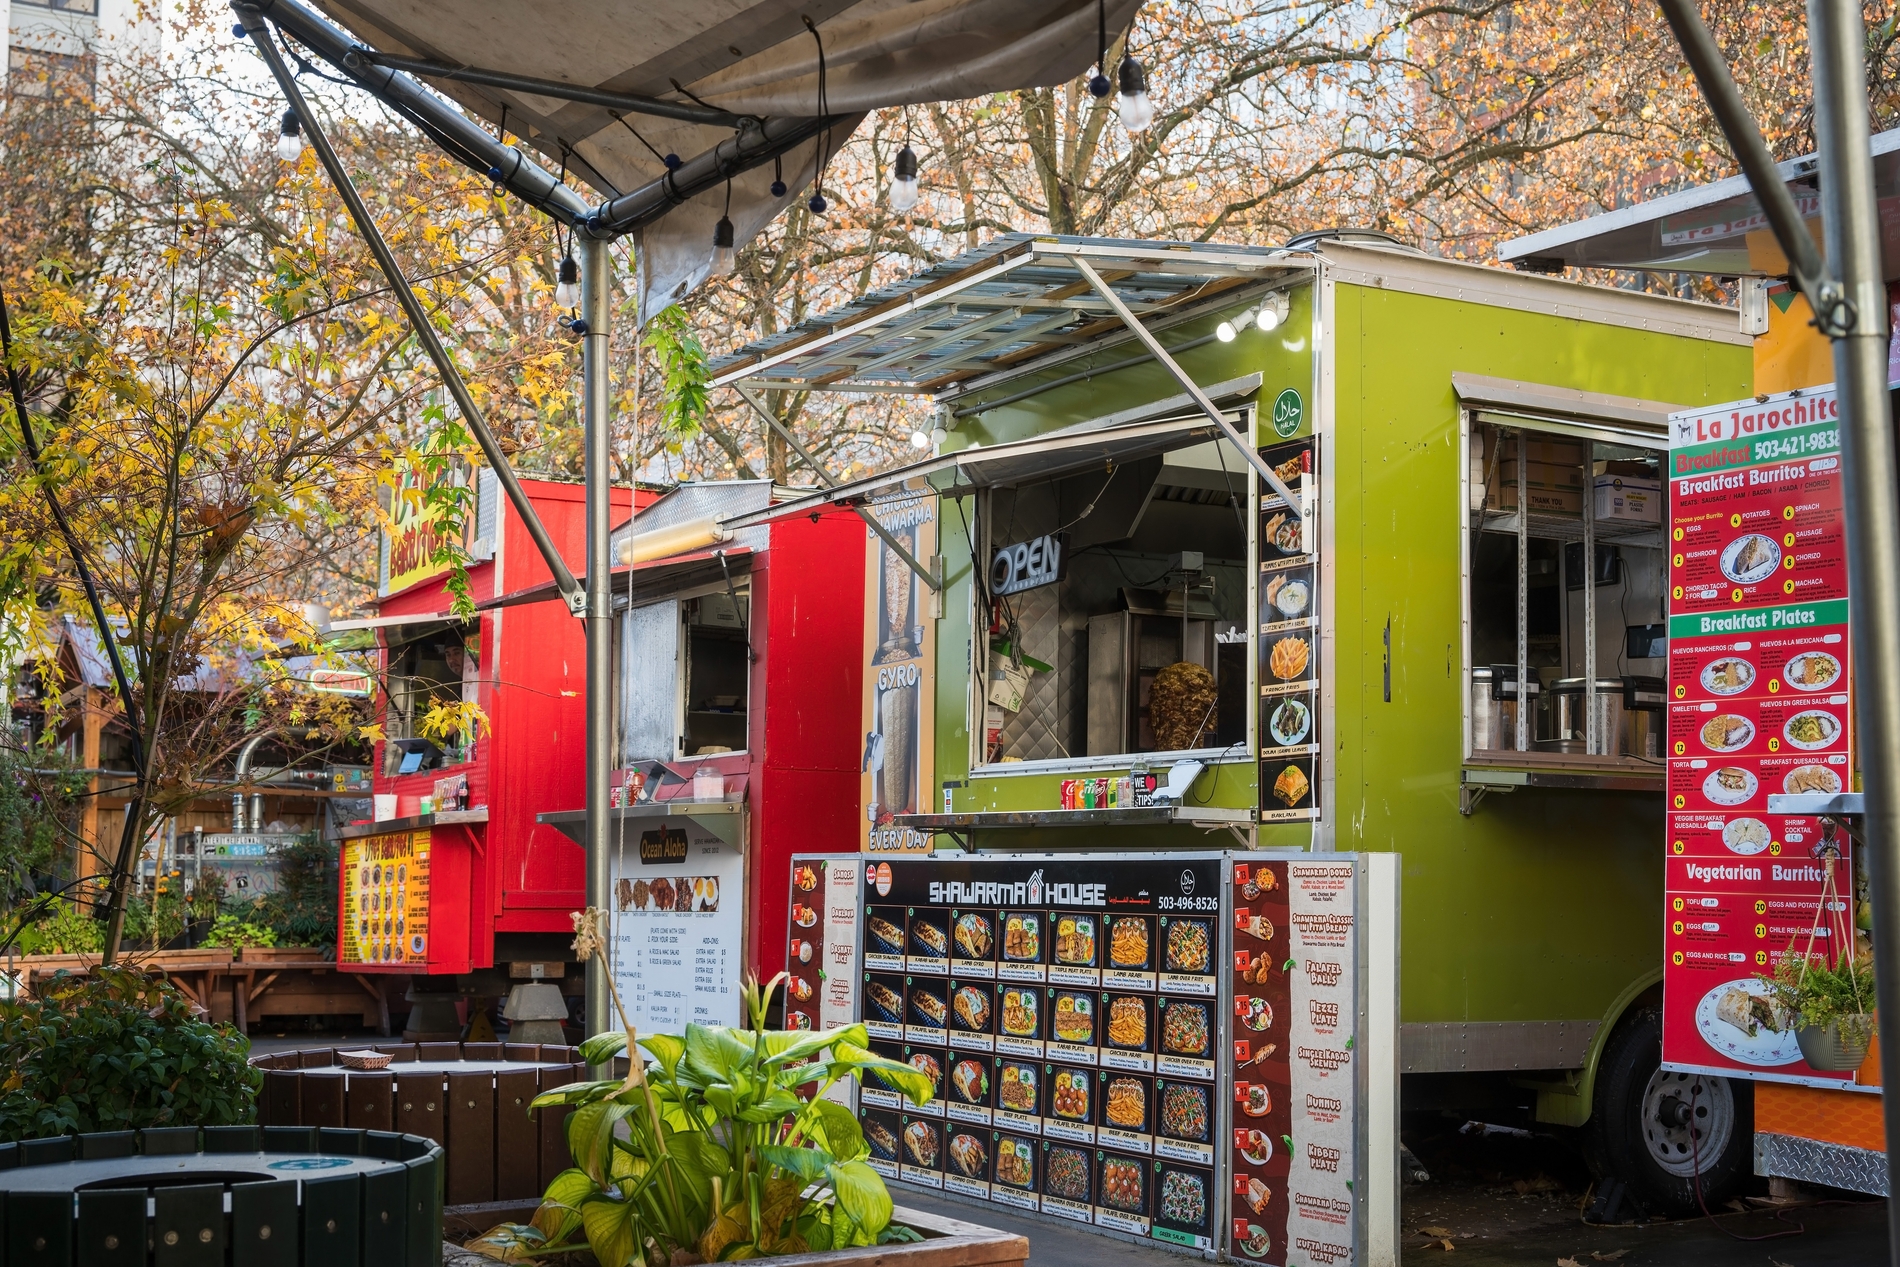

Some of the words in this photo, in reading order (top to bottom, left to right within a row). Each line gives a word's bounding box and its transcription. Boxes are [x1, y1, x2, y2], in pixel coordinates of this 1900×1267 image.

[1280, 419, 1295, 429] HALAL
[1697, 419, 1721, 441] La
[1755, 429, 1840, 460] 503-421-9838
[1676, 445, 1750, 473] Breakfast
[1680, 476, 1744, 496] Breakfast
[1750, 463, 1805, 485] Burritos
[1532, 496, 1550, 504] THANK
[1551, 497, 1562, 505] YOU
[1680, 498, 1698, 506] MEATS:
[1702, 495, 1727, 504] SAUSAGE
[1753, 488, 1771, 496] BACON
[1779, 484, 1798, 493] ASADA
[1805, 480, 1830, 488] CHORIZO
[1795, 503, 1819, 512] SPINACH
[1695, 515, 1706, 523] your
[1733, 517, 1738, 525] 4
[1742, 510, 1770, 519] POTATOES
[1787, 536, 1791, 544] 7
[1796, 529, 1822, 537] SAUSAGE
[1687, 549, 1717, 558] MUSHROOM
[1787, 558, 1791, 566] 8
[1796, 552, 1821, 561] CHORIZO
[990, 534, 1061, 596] OPEN
[1676, 589, 1680, 597] 3
[1686, 584, 1709, 592] CHORIZO
[1701, 615, 1767, 633] Breakfast
[1772, 610, 1815, 626] Plates
[1695, 645, 1726, 653] RANCHEROS
[1760, 640, 1781, 648] HUEVOS
[1796, 637, 1823, 645] MEXICANA
[313, 672, 368, 691] OPEN
[878, 663, 917, 691] GYRO
[1134, 777, 1144, 788] WE
[869, 830, 903, 850] EVERY
[906, 828, 929, 849] DAY
[641, 838, 663, 859] Ocean
[663, 837, 685, 857] Aloha
[1686, 864, 1761, 882] Vegetarian
[929, 882, 1025, 904] SHAWARMA
[1046, 883, 1106, 906] HOUSE
[1159, 896, 1218, 910] 503-496-8526
[1675, 954, 1681, 962] 19
[1015, 1190, 1029, 1198] PLATE
[1172, 1233, 1185, 1241] SALAD
